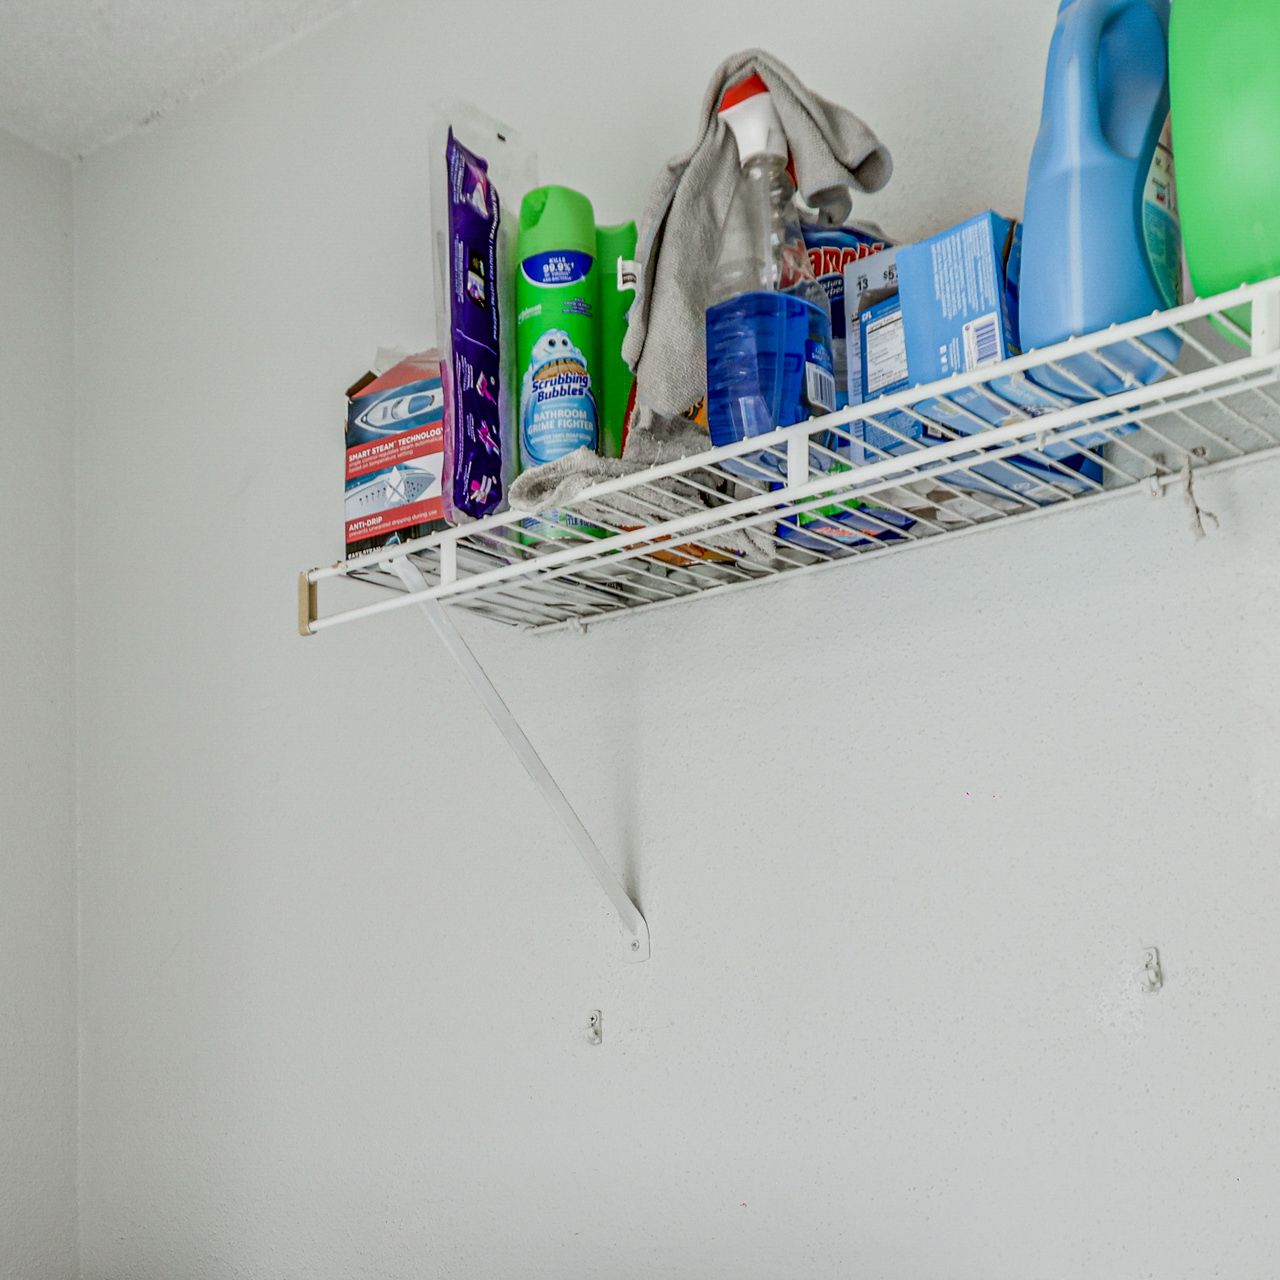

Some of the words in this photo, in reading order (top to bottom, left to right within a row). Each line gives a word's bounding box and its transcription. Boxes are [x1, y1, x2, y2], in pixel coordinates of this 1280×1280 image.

[532, 373, 588, 392] Scrubbing
[537, 385, 584, 402] Bubbles
[534, 408, 587, 421] BATHROOM
[528, 420, 555, 434] GRIME
[558, 418, 594, 431] FIGHTER
[348, 448, 371, 462] SMART
[348, 516, 383, 531] ANTI-DRIP
